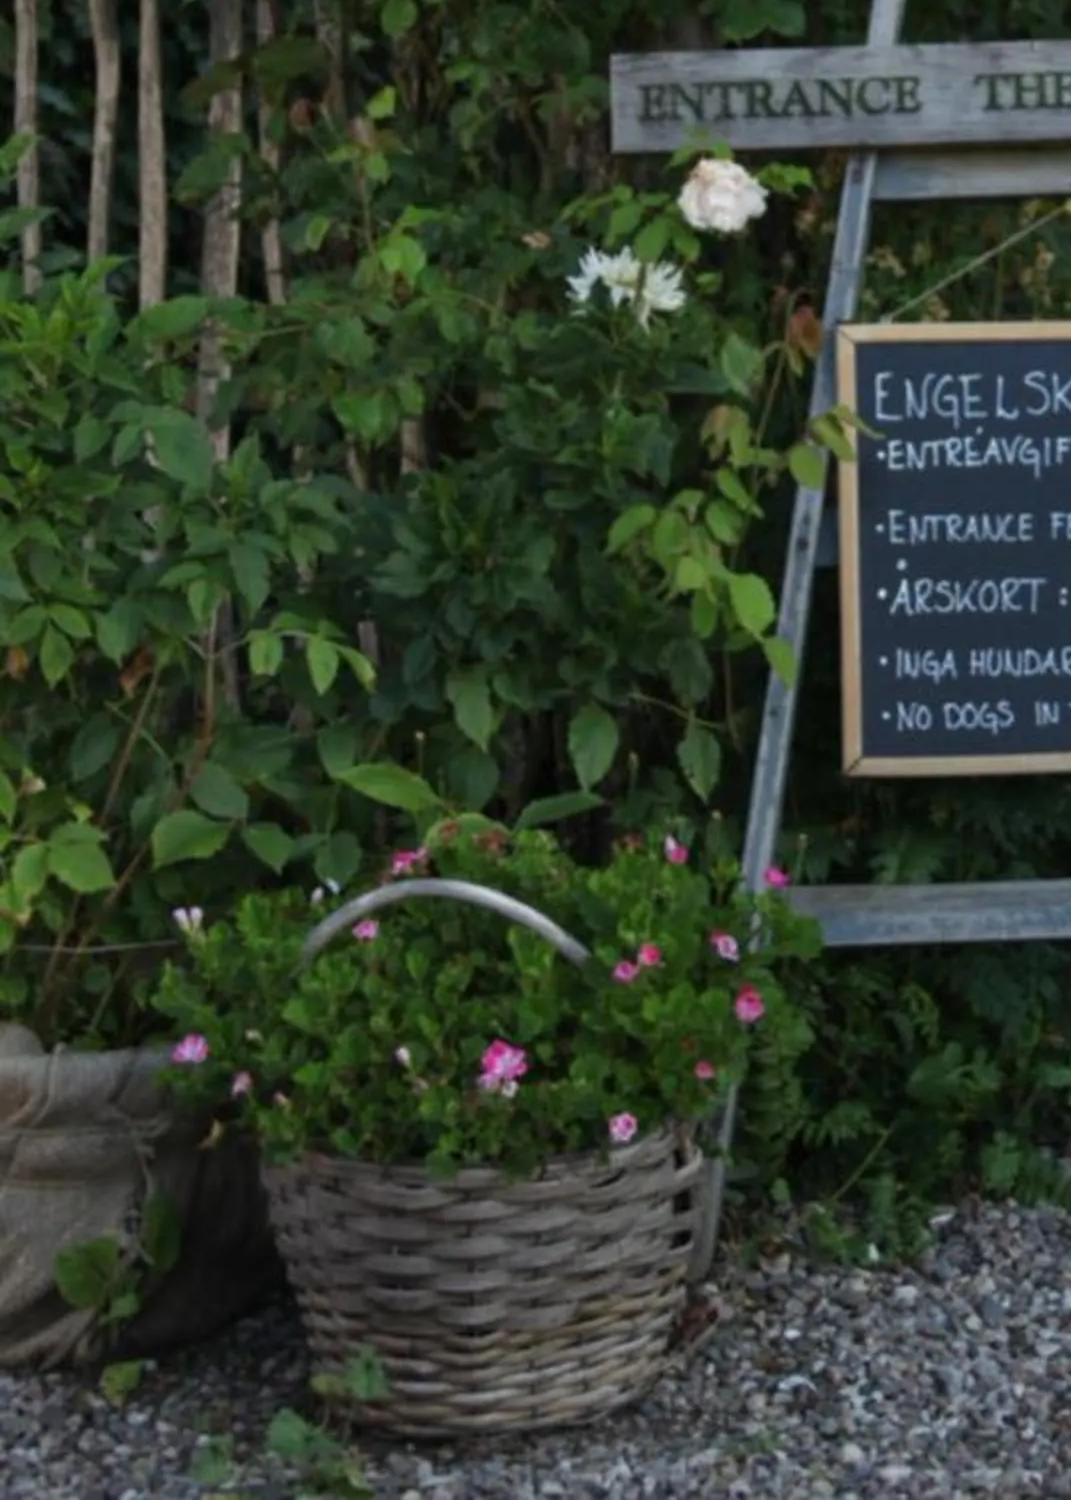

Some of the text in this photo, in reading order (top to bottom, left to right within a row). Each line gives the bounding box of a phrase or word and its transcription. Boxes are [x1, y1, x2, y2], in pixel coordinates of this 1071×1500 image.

[638, 75, 922, 123] ENTRANCE
[888, 509, 1034, 545] ENTRANCE
[889, 558, 1047, 616] ÅRSKORT
[895, 647, 957, 684] INGA
[896, 701, 933, 732] NO
[943, 700, 1016, 736] DOGS
[1033, 701, 1060, 728] IN
